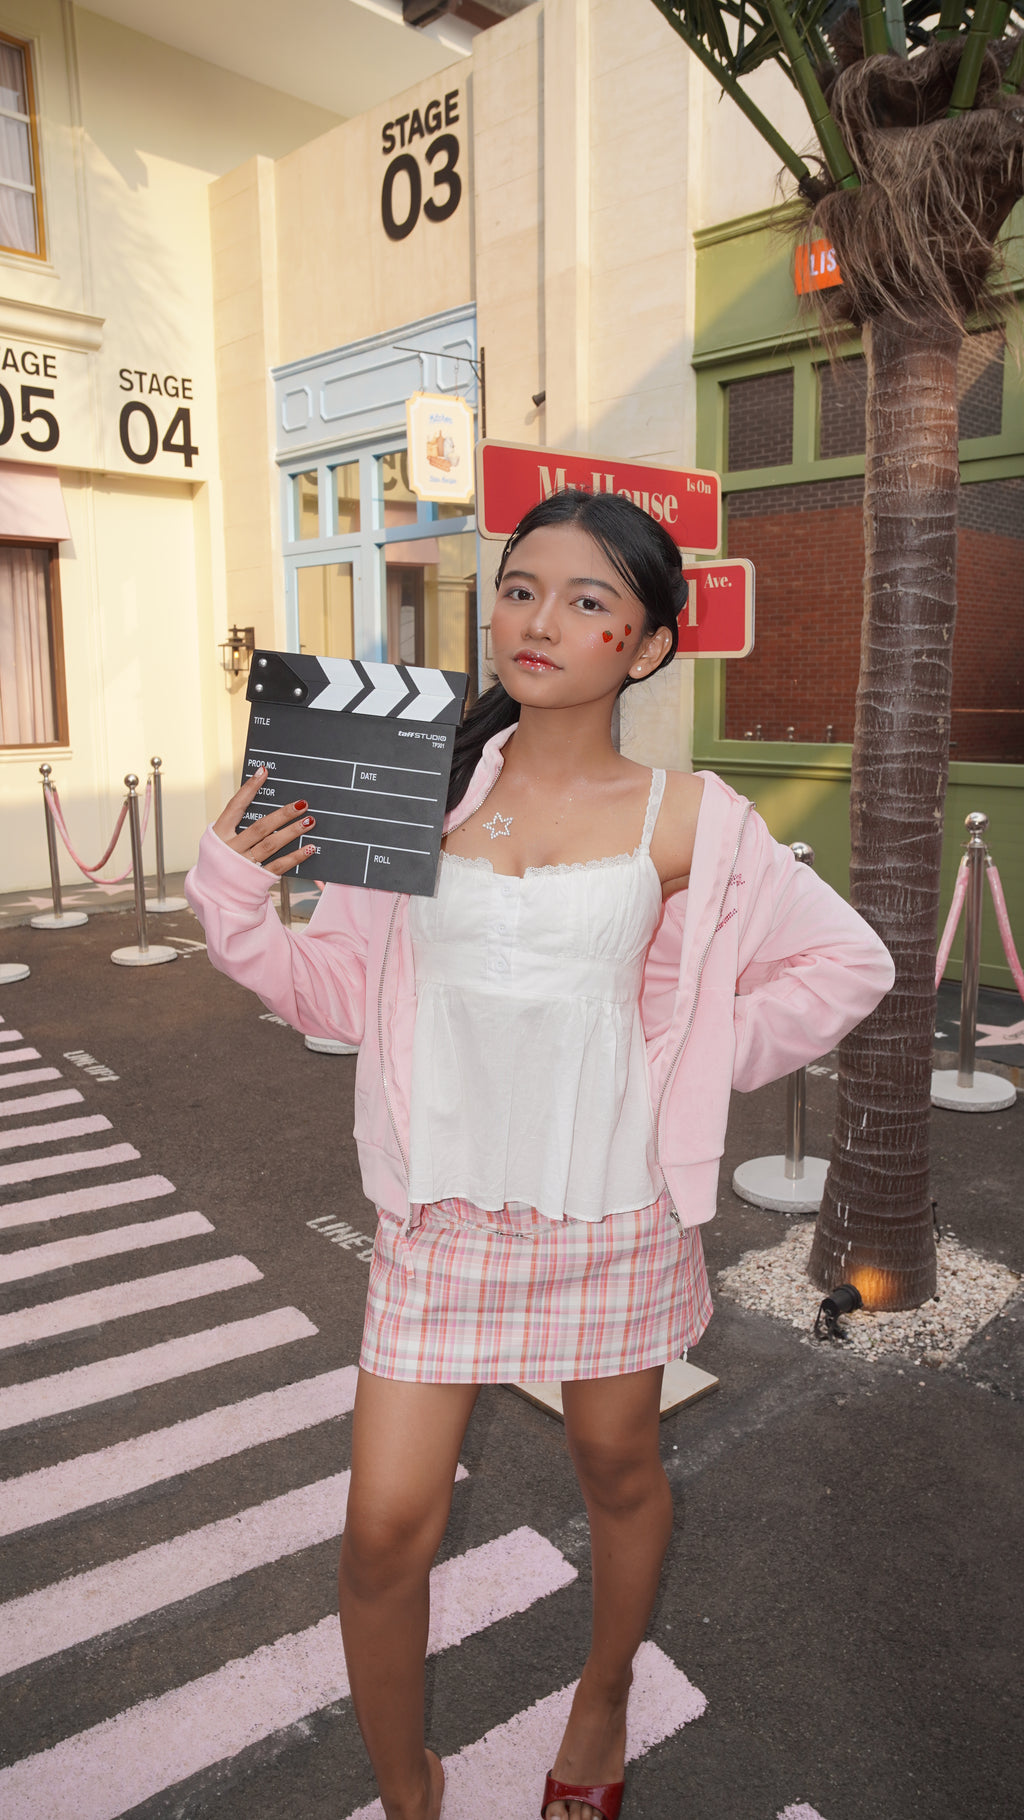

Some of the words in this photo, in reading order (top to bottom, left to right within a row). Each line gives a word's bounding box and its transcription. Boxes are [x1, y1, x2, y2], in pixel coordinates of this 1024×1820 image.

[382, 88, 460, 155] STAGE
[381, 133, 462, 242] 03
[119, 368, 194, 400] STAGE
[119, 400, 199, 468] 04
[687, 478, 696, 492] Is
[697, 479, 711, 494] On
[704, 572, 732, 589] Ave.
[254, 716, 271, 726] TITLE
[360, 771, 377, 781] DATE
[374, 854, 391, 865] ROLL
[306, 1213, 376, 1250] LINE
